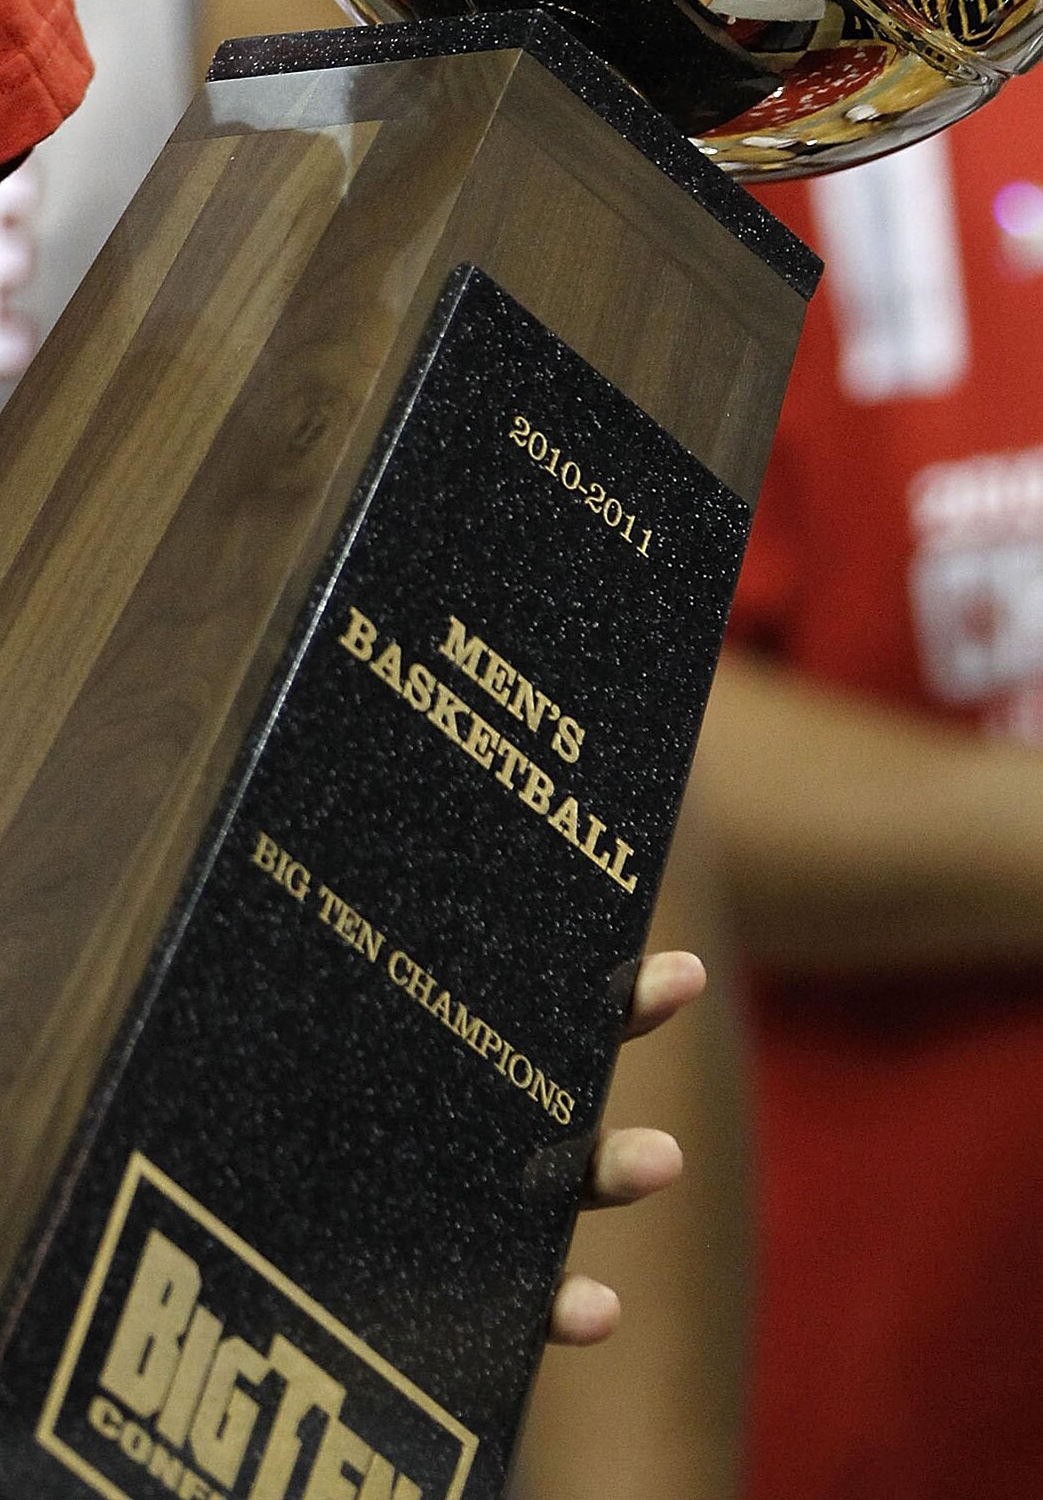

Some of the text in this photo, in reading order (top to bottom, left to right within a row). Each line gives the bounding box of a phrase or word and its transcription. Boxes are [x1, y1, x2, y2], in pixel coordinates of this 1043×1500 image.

[508, 415, 653, 559] 2010-2011
[339, 605, 638, 894] BASKETBALL
[439, 614, 585, 764] MEN'S
[252, 830, 576, 1126] BIG TEN CHAMPIONS
[87, 1396, 227, 1500] CONF
